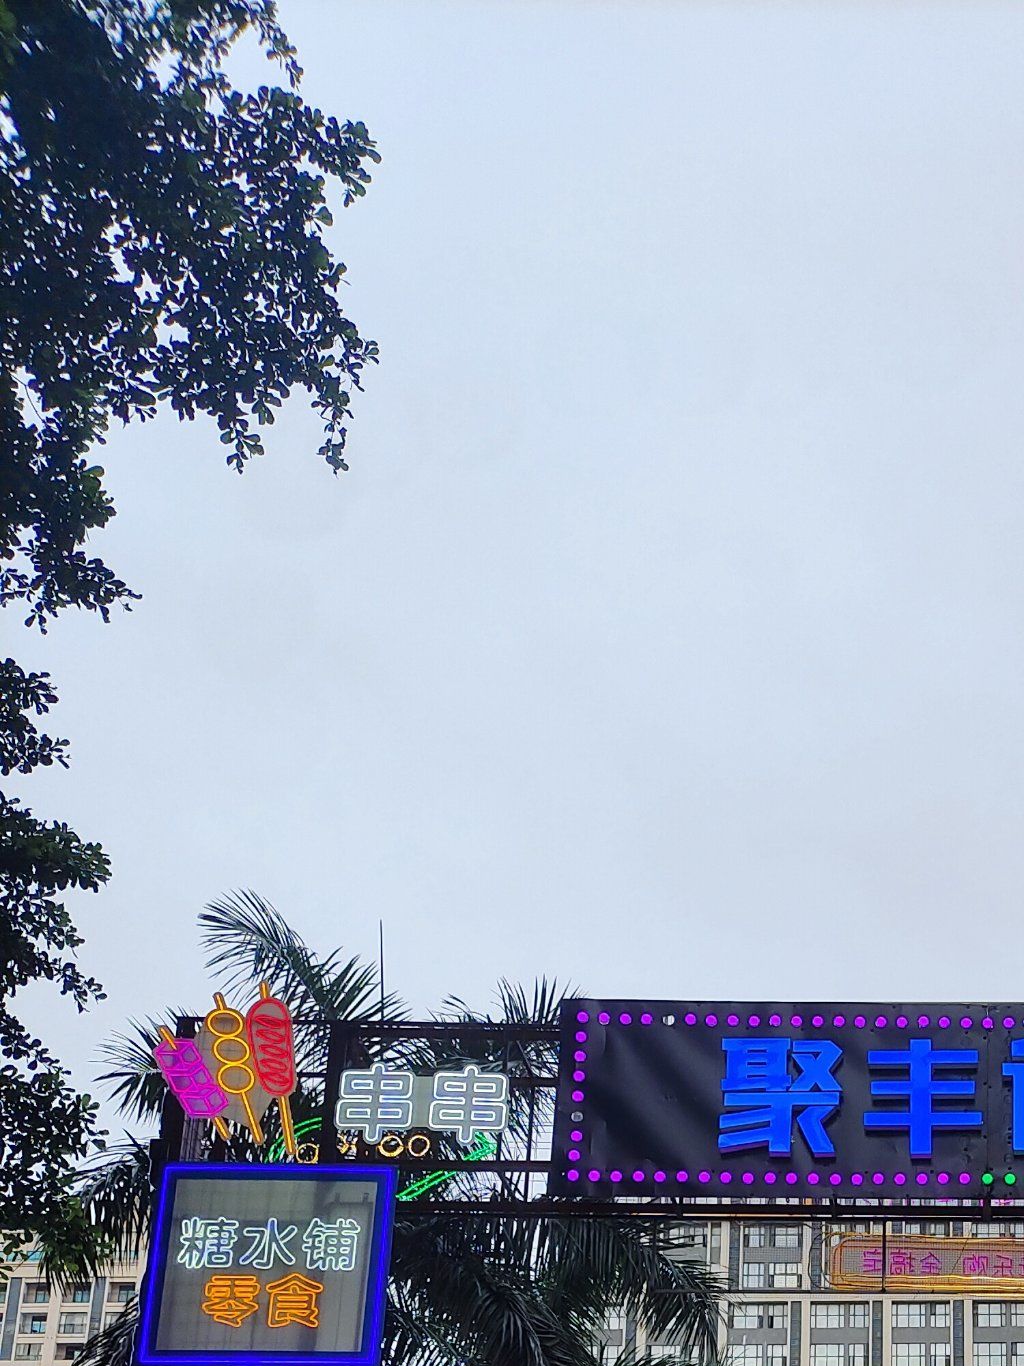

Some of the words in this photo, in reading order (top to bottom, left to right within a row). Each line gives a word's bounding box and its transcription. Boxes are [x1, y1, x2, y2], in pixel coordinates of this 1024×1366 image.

[335, 1063, 508, 1145] 串串
[177, 1217, 361, 1271] 糖水铺
[201, 1273, 324, 1328] 零食
